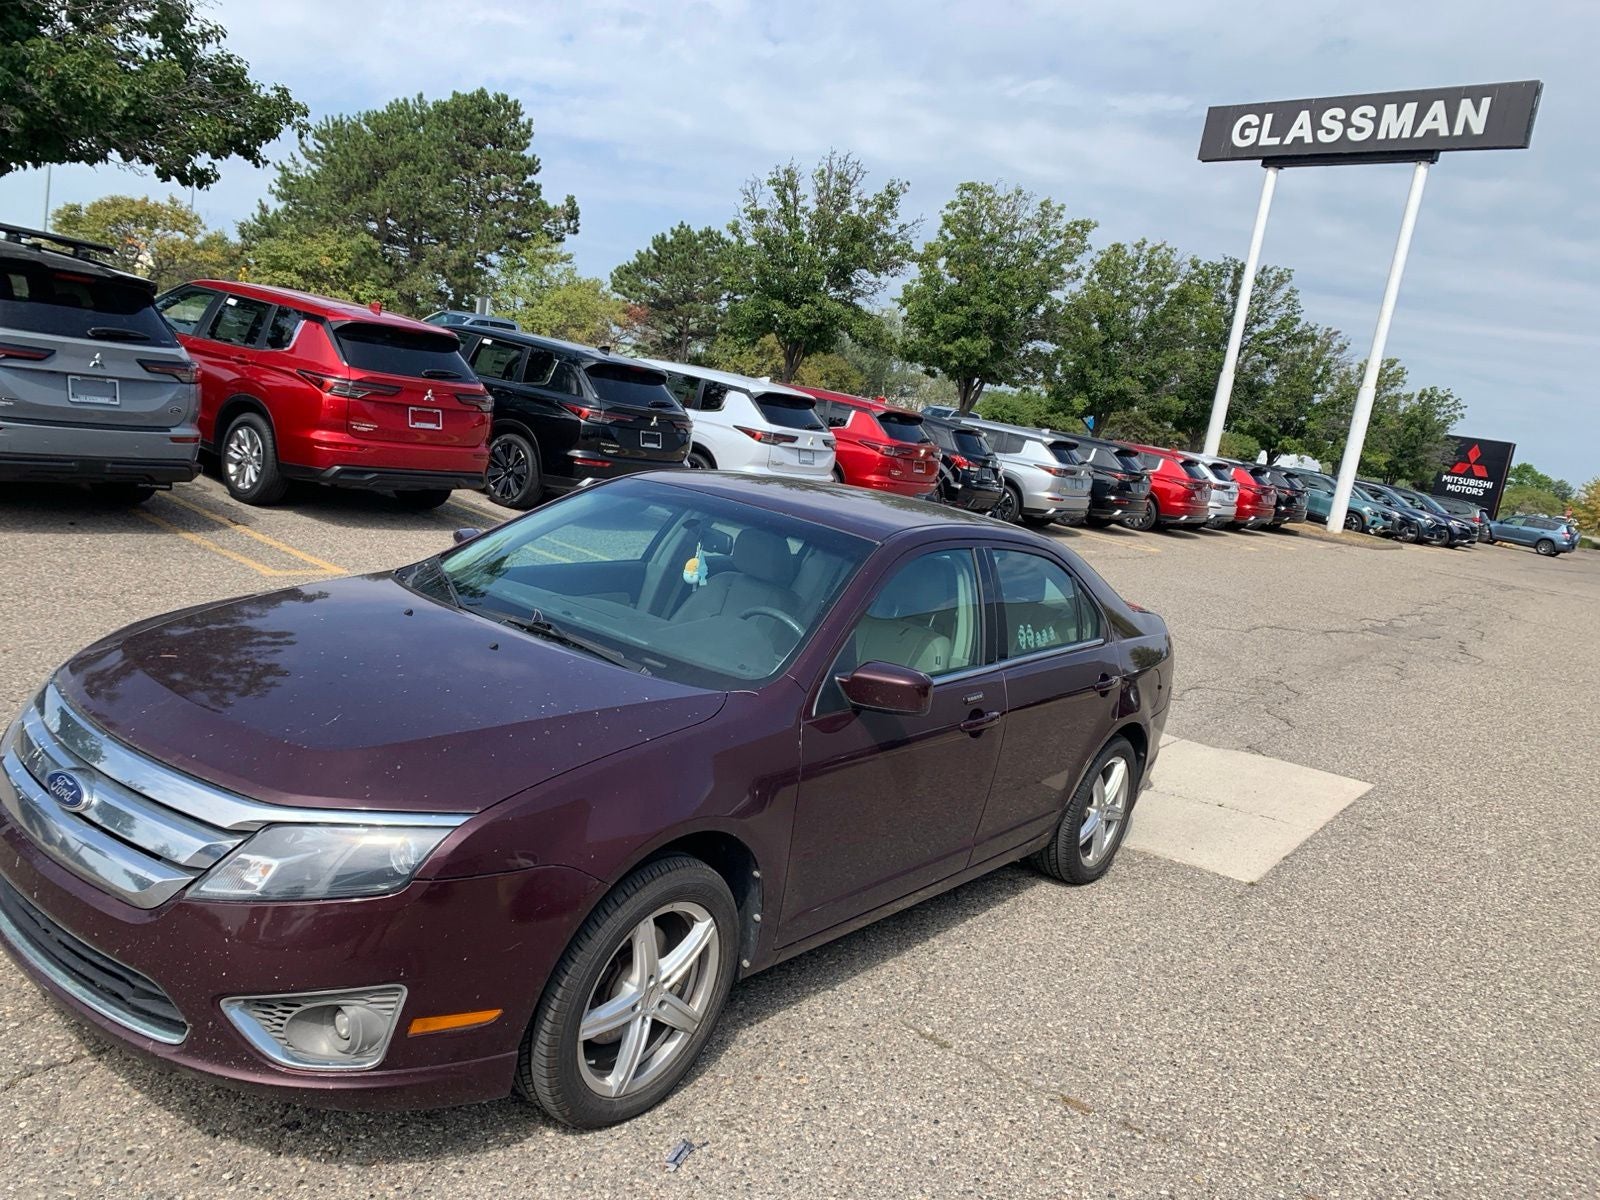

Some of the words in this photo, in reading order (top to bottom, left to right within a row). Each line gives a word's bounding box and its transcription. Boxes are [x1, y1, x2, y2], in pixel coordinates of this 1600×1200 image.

[1231, 96, 1492, 148] GLASSMAN
[1442, 474, 1494, 489] MITSUBISHI
[1446, 484, 1485, 496] MOTORS
[51, 775, 77, 802] Ford
